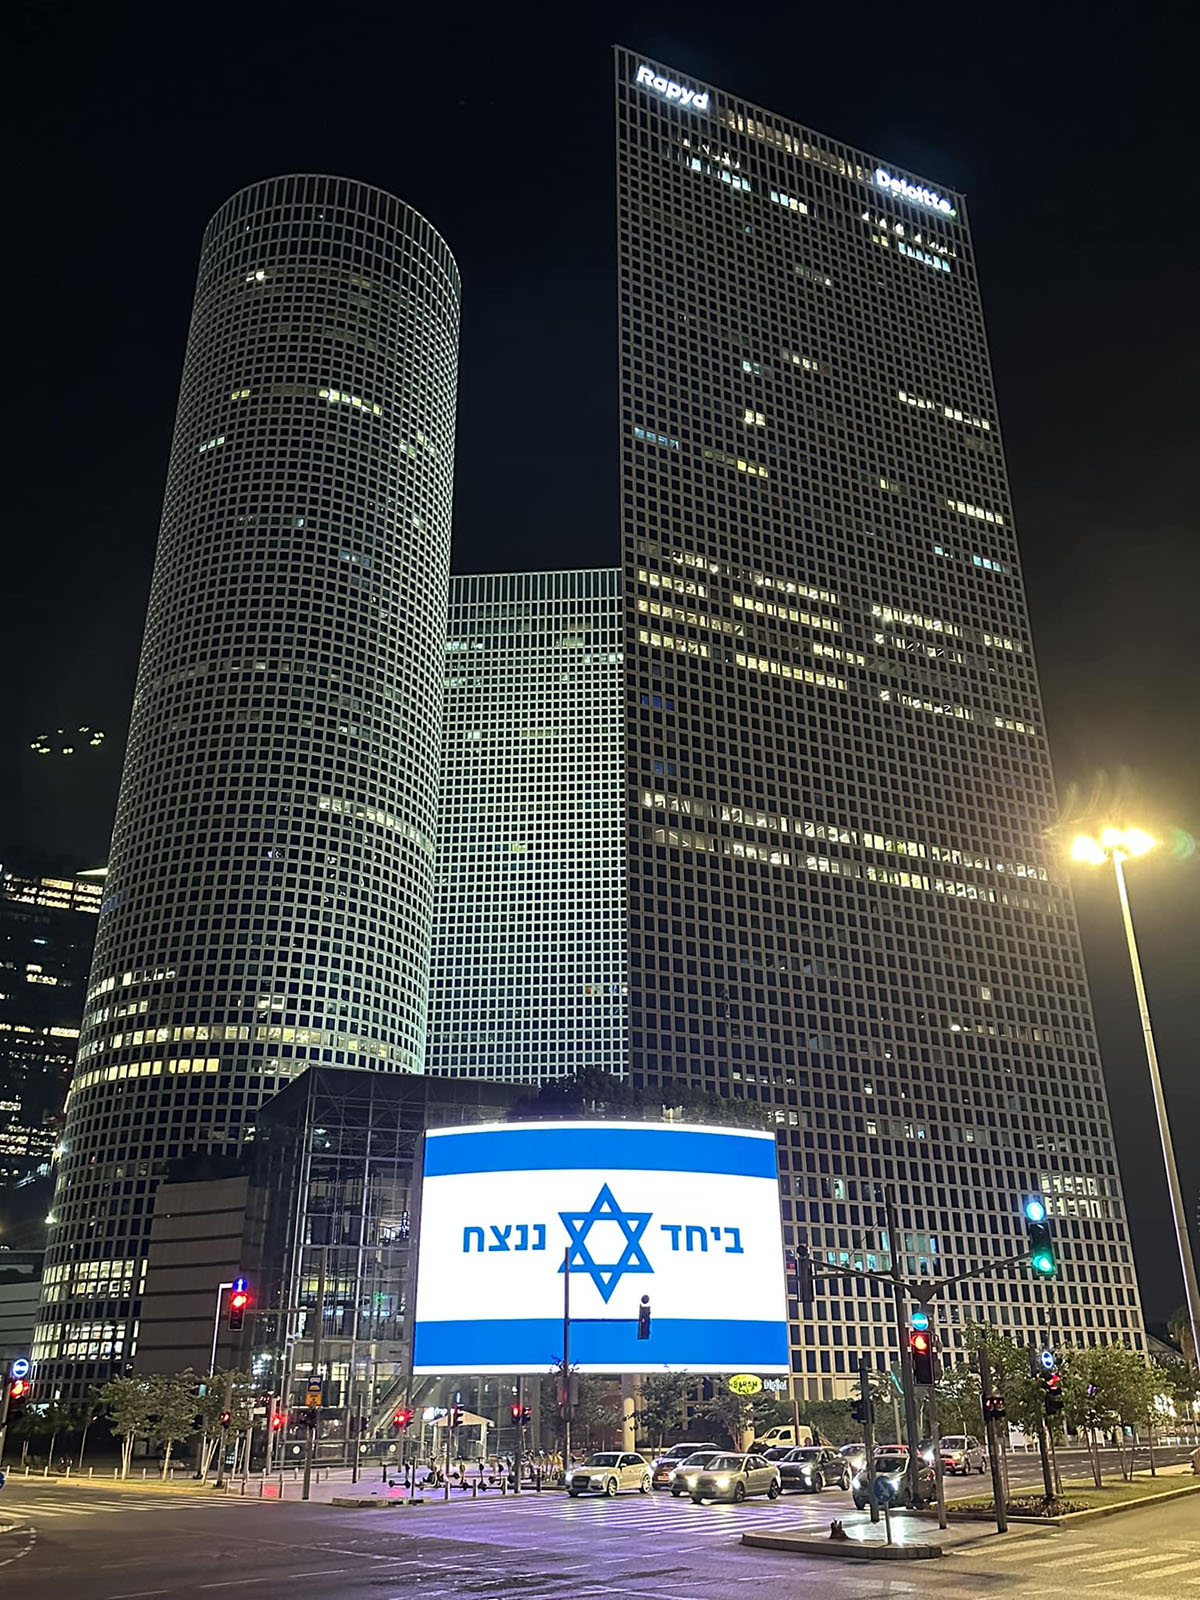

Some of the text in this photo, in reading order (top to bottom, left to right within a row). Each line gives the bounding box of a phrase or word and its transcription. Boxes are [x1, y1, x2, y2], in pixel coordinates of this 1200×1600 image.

[636, 64, 710, 110] Rapyd
[463, 1224, 744, 1254] ביחד ננצח
